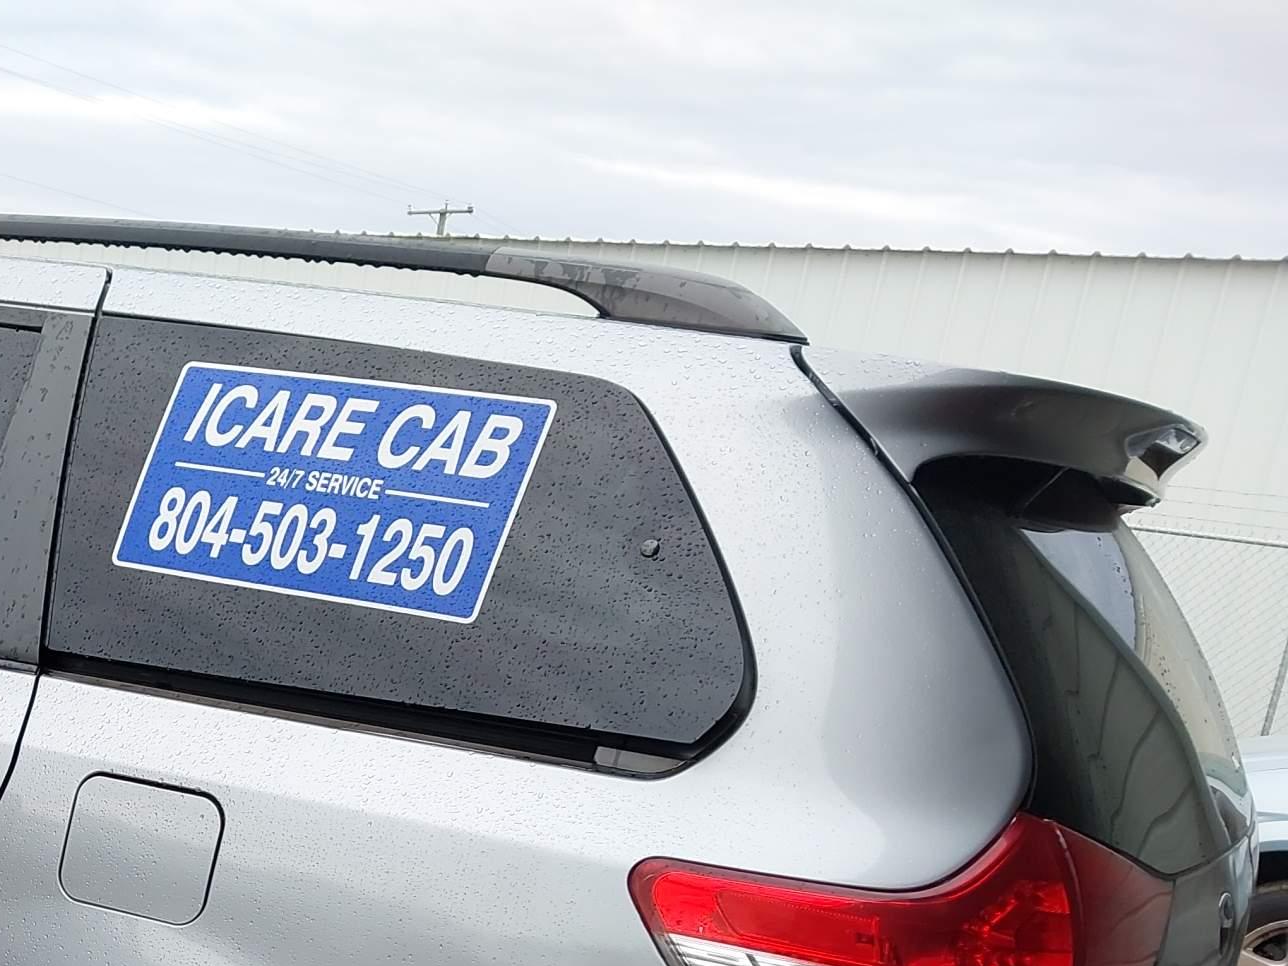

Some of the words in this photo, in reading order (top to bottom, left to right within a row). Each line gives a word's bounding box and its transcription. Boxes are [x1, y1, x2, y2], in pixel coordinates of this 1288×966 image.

[183, 382, 380, 462] ICARE
[377, 404, 524, 479] CAB
[265, 466, 307, 490] 24/7
[305, 470, 385, 500] SERVICE
[148, 486, 474, 596] 804-503-1250
